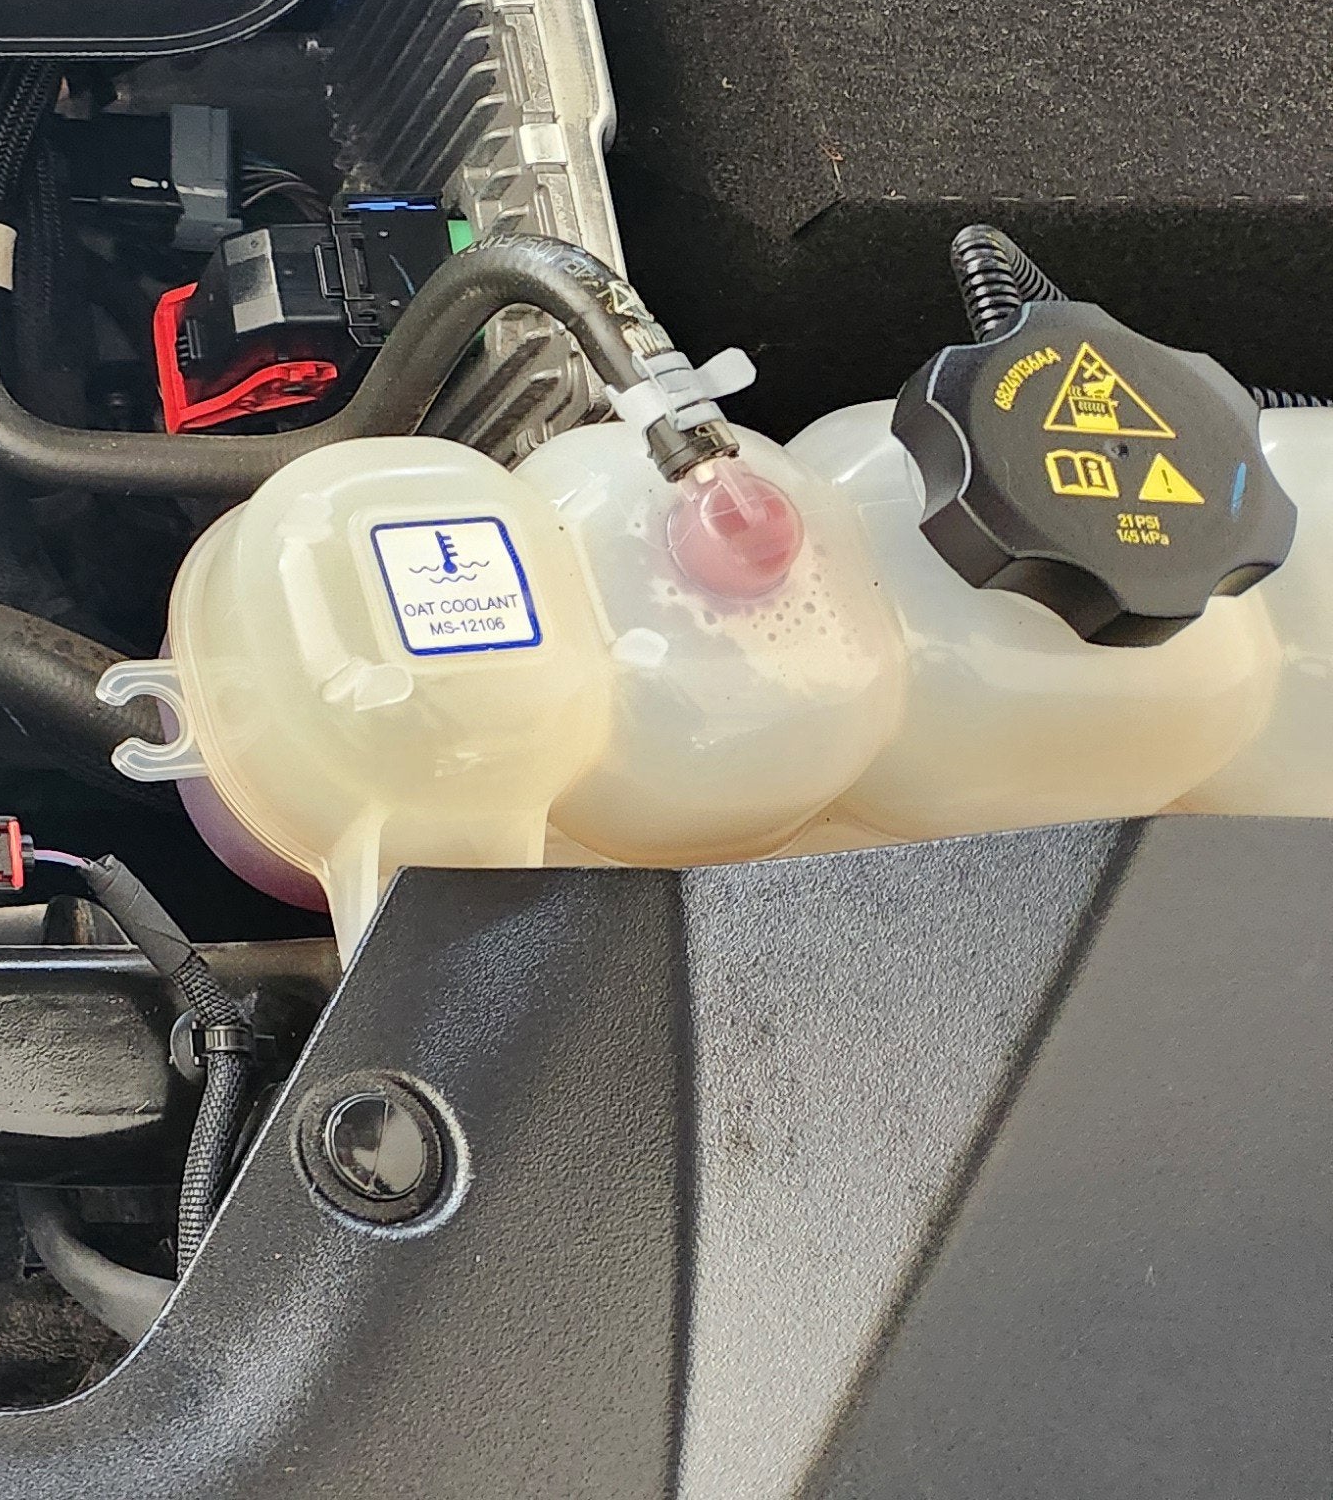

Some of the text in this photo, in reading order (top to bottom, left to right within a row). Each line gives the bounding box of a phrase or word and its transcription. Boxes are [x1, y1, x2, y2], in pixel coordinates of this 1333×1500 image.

[993, 346, 1062, 411] 68249136AA
[1116, 513, 1161, 530] 21 PSI
[1116, 529, 1171, 546] 145 kPa
[403, 594, 518, 617] OAT COOLANT
[429, 616, 506, 636] MS-12106
